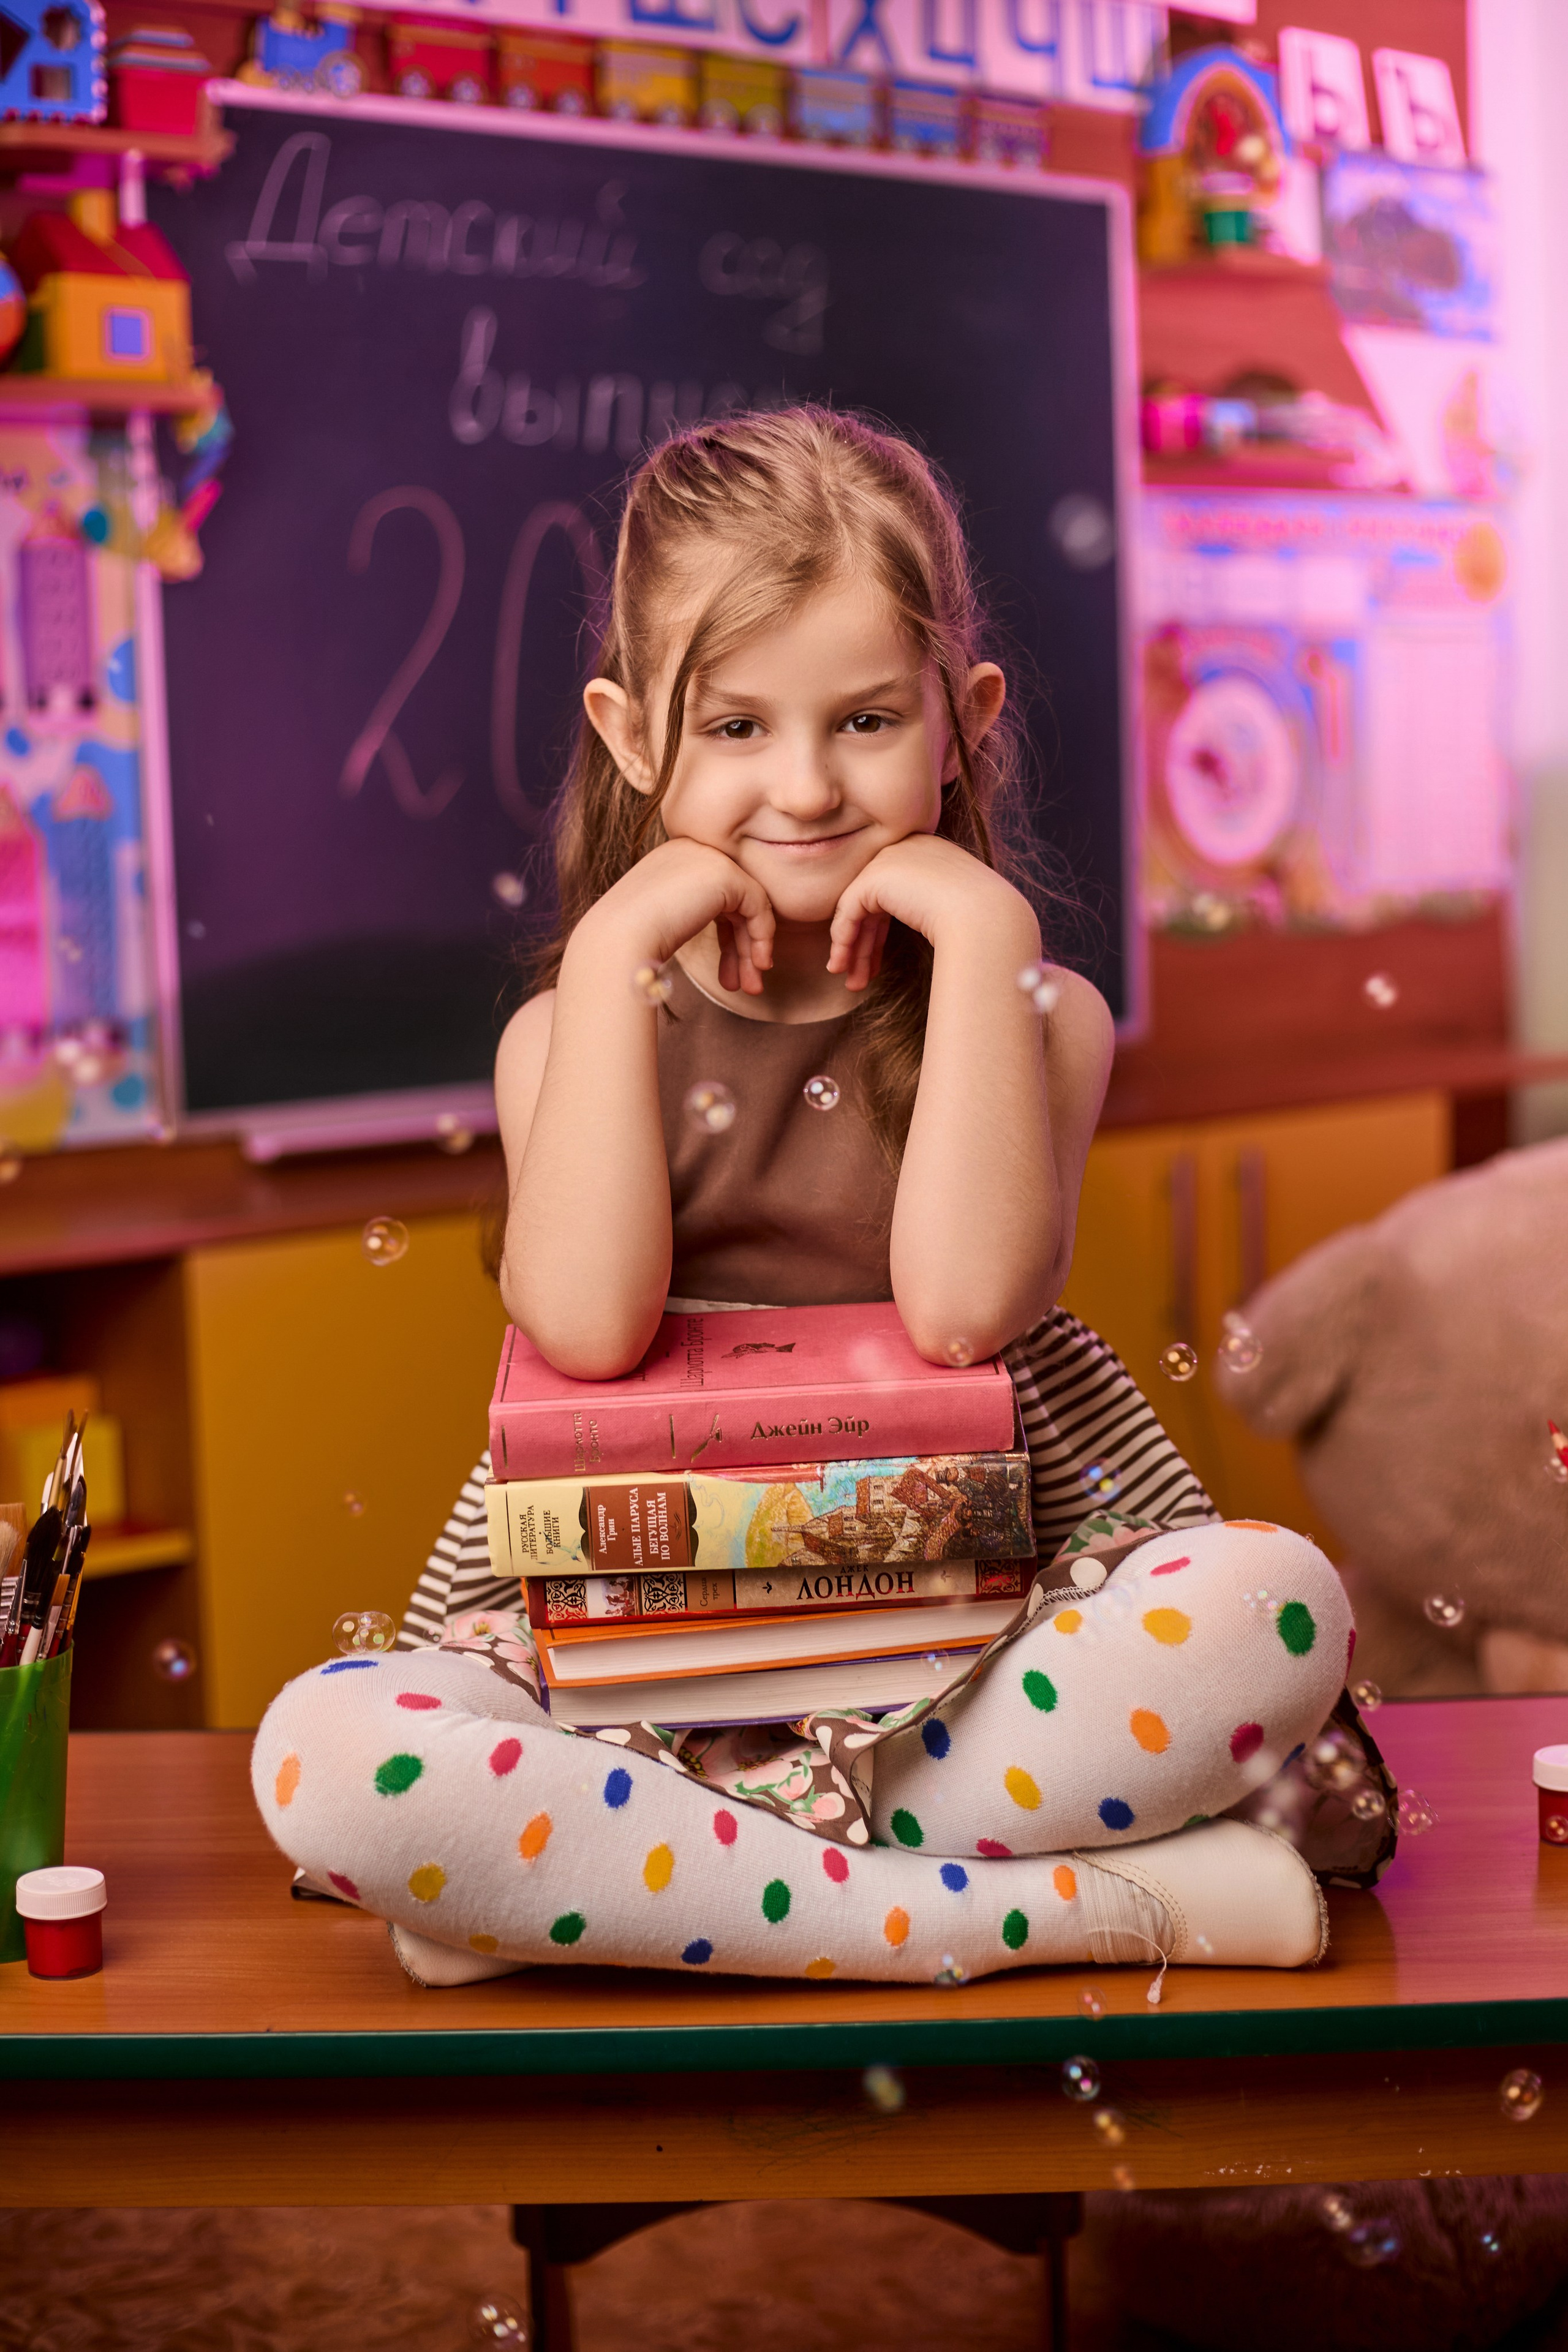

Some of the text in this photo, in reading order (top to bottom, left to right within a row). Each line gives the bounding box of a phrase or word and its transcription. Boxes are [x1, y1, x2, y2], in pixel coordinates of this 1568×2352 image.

[224, 131, 834, 357] Детский сад
[680, 1318, 712, 1387] Шарлотта Бронте
[574, 1412, 588, 1471] Шарлотта
[589, 1420, 603, 1463] Бронте
[750, 1415, 870, 1441] Джейн Эйр
[519, 1514, 529, 1553] РУССКАЯ
[527, 1505, 538, 1560] ЛИТЕРАТУРА
[543, 1510, 554, 1555] БОЛЬШИЕ
[552, 1517, 561, 1548] КНИГИ
[597, 1504, 607, 1554] Александр
[607, 1518, 617, 1541] Грин
[629, 1487, 643, 1566] АЛЫЕ ПАРУСА
[646, 1499, 659, 1555] БЕГУЩАЯ
[657, 1492, 670, 1560] ПО ВОЛНАМ
[796, 1571, 915, 1600] ЛОНДОН
[840, 1564, 869, 1574] ДЖЕК
[700, 1577, 709, 1607] Сердца
